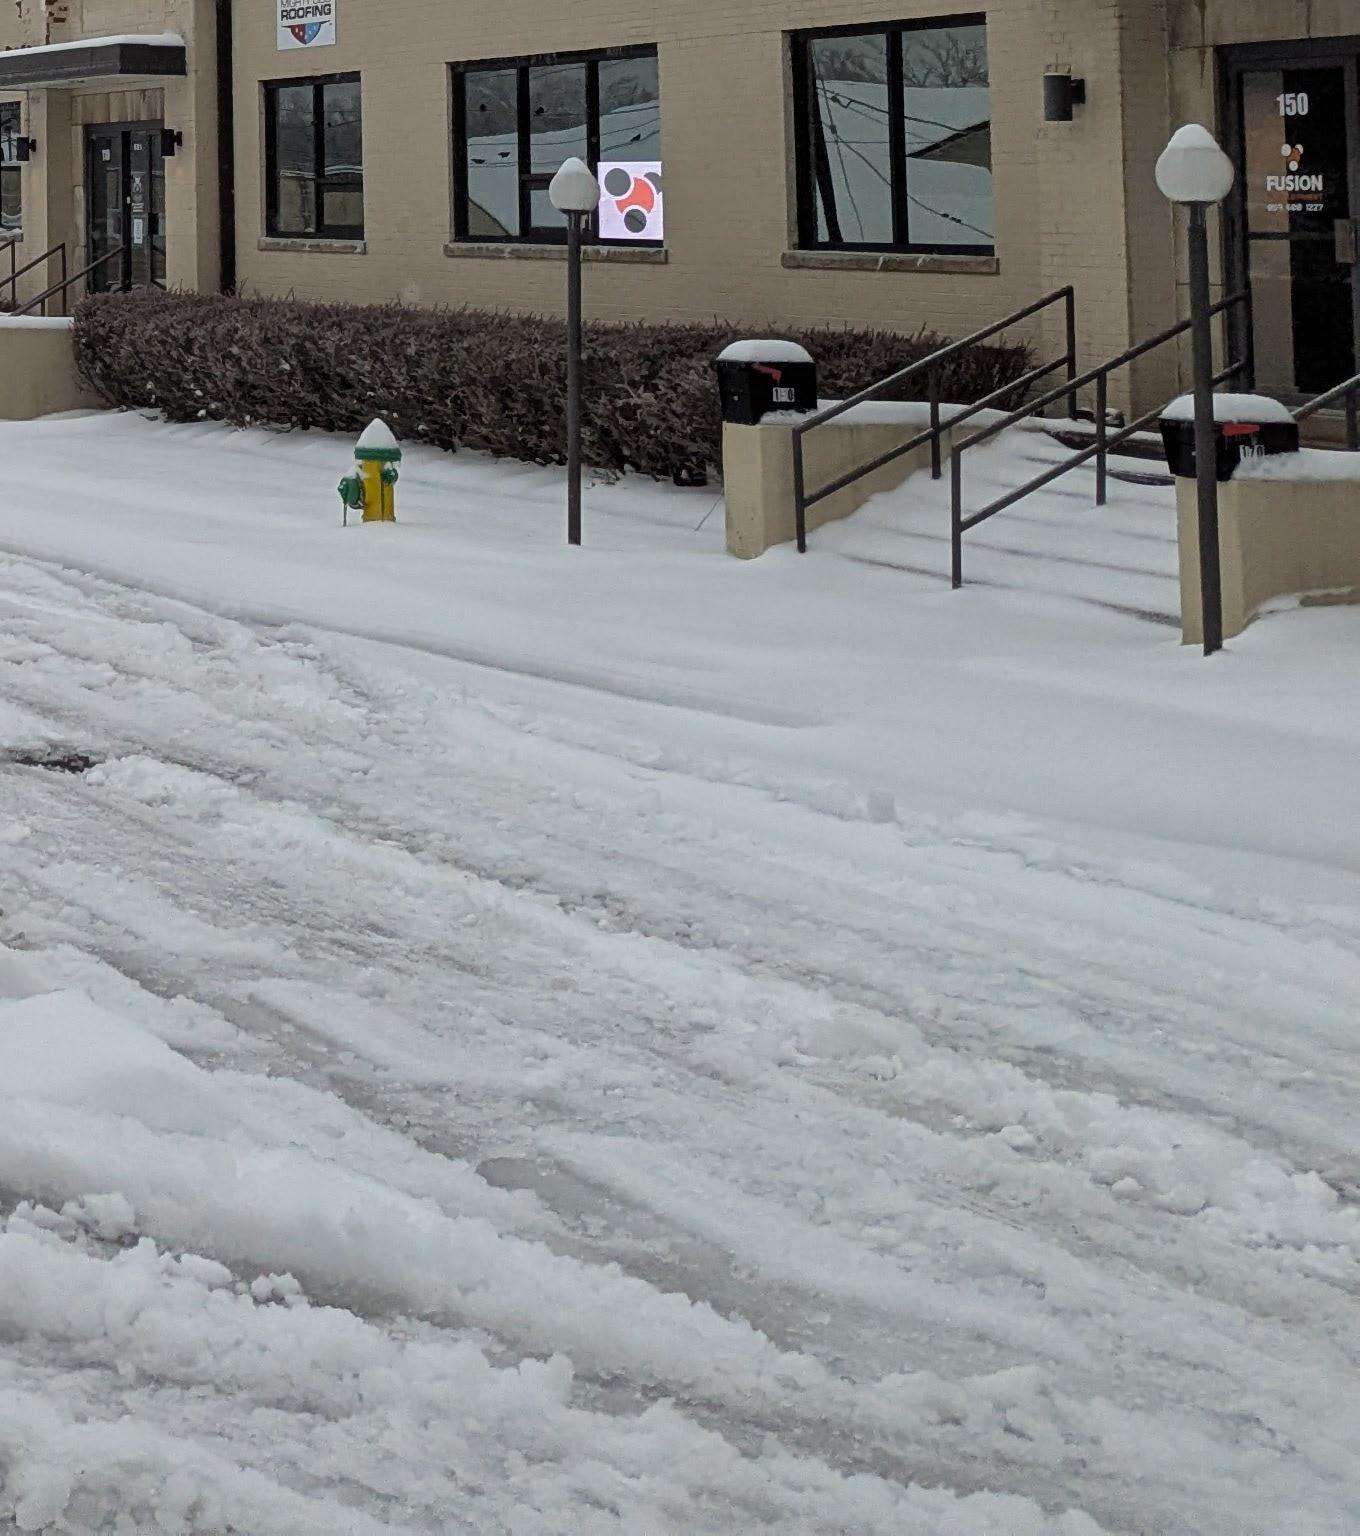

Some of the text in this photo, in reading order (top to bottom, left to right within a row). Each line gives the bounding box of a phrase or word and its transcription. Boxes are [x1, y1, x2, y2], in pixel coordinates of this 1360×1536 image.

[281, 4, 331, 21] ROOFING
[1276, 92, 1309, 116] 150
[1266, 174, 1323, 192] FUSION
